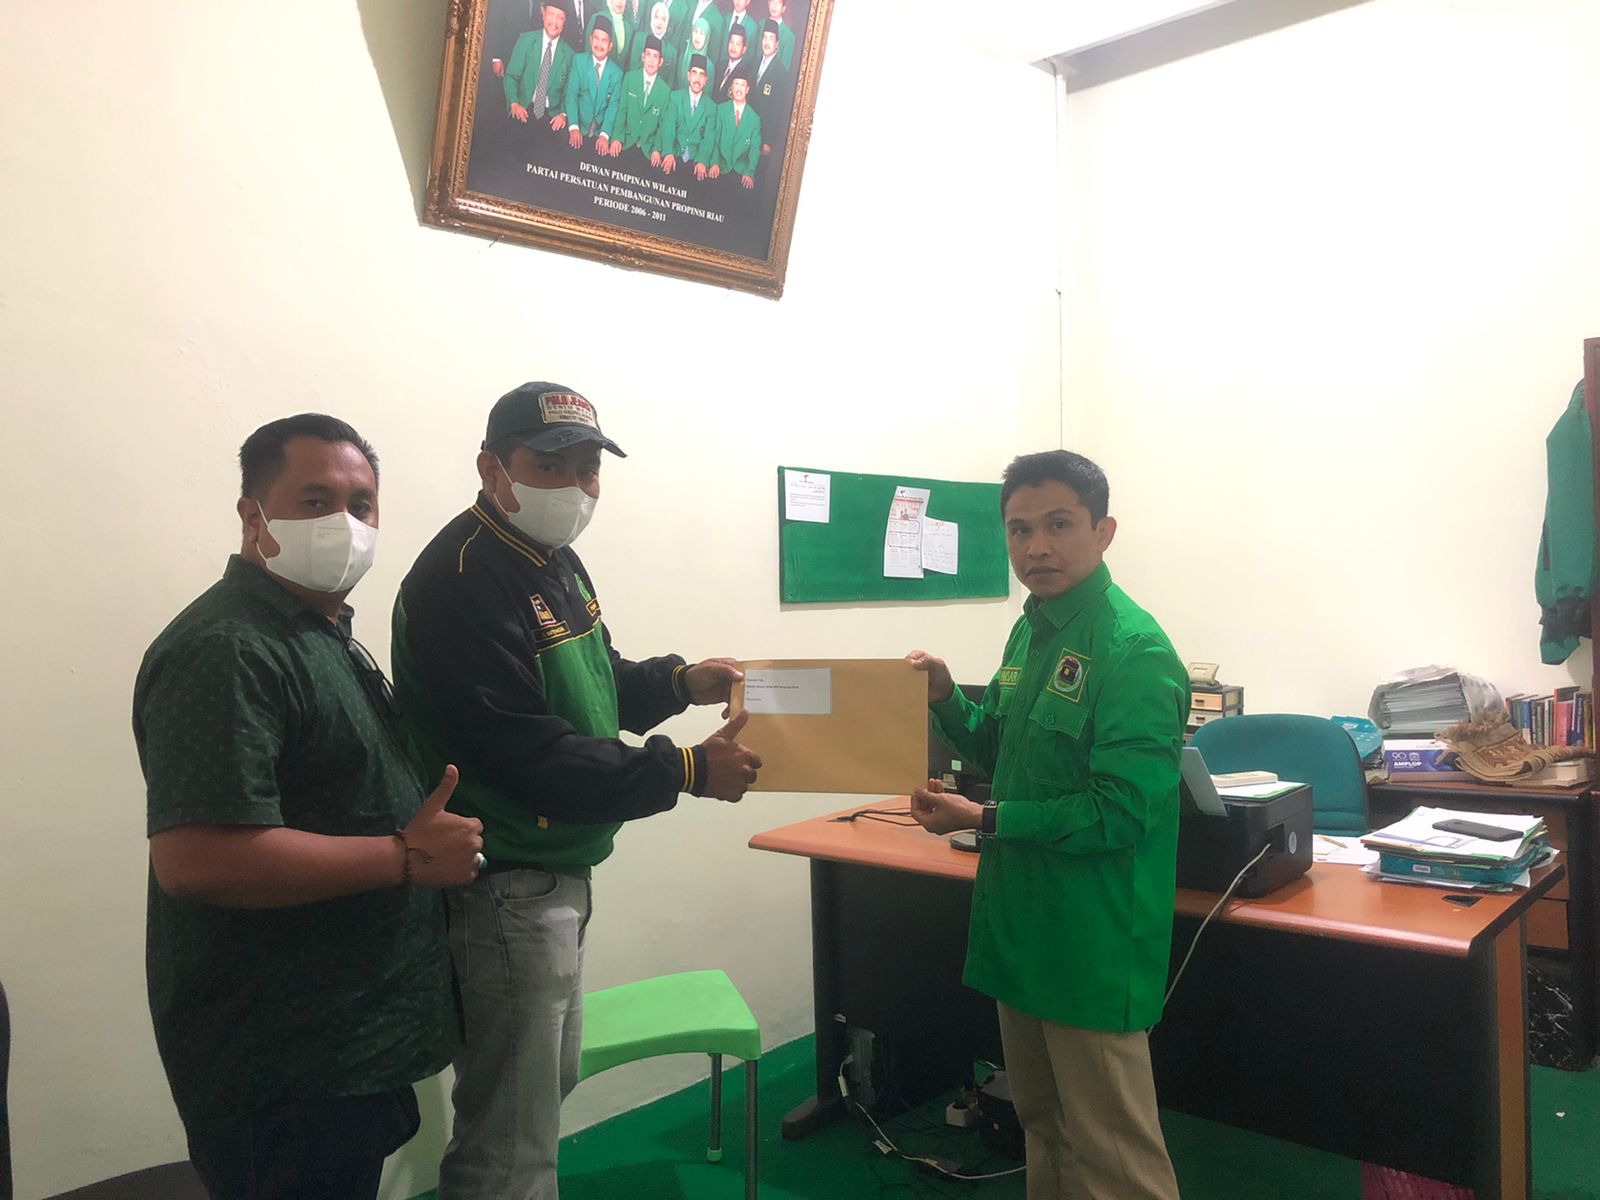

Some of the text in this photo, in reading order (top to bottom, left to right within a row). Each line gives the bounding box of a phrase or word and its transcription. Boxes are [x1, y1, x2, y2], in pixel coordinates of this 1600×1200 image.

[526, 163, 726, 223] PARTAI PERSATUAN PEMBANGUNAN PROPINSI RIAU
[579, 161, 688, 198] DEWAN PIMPINAN WILAYAH
[593, 196, 629, 213] PERIODE
[630, 205, 647, 217] 2006
[651, 211, 667, 222] 2011
